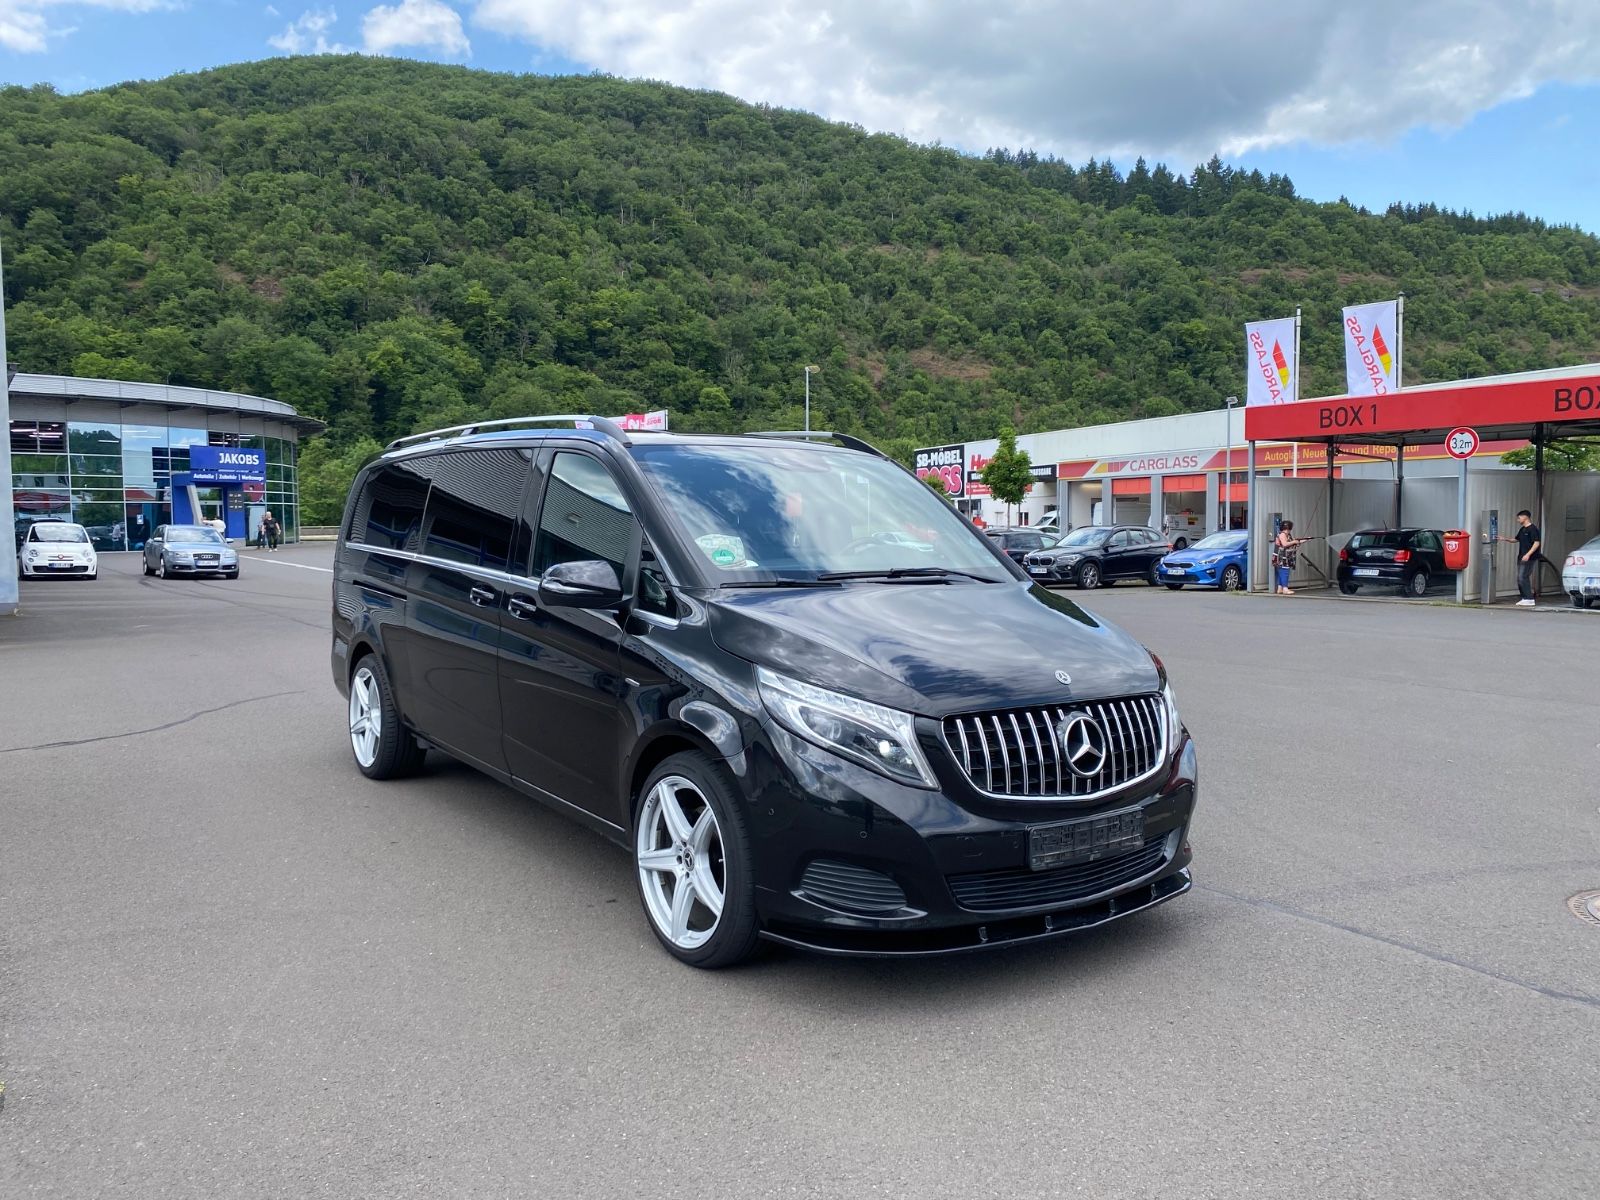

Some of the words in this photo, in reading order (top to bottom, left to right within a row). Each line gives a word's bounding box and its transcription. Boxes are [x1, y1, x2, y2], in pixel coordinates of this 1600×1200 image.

[1319, 405, 1364, 428] BOX
[1371, 404, 1377, 425] 1
[219, 452, 260, 465] JAKOBS
[916, 448, 963, 467] SB-MÖBEL
[1129, 455, 1198, 472] CARGLASS
